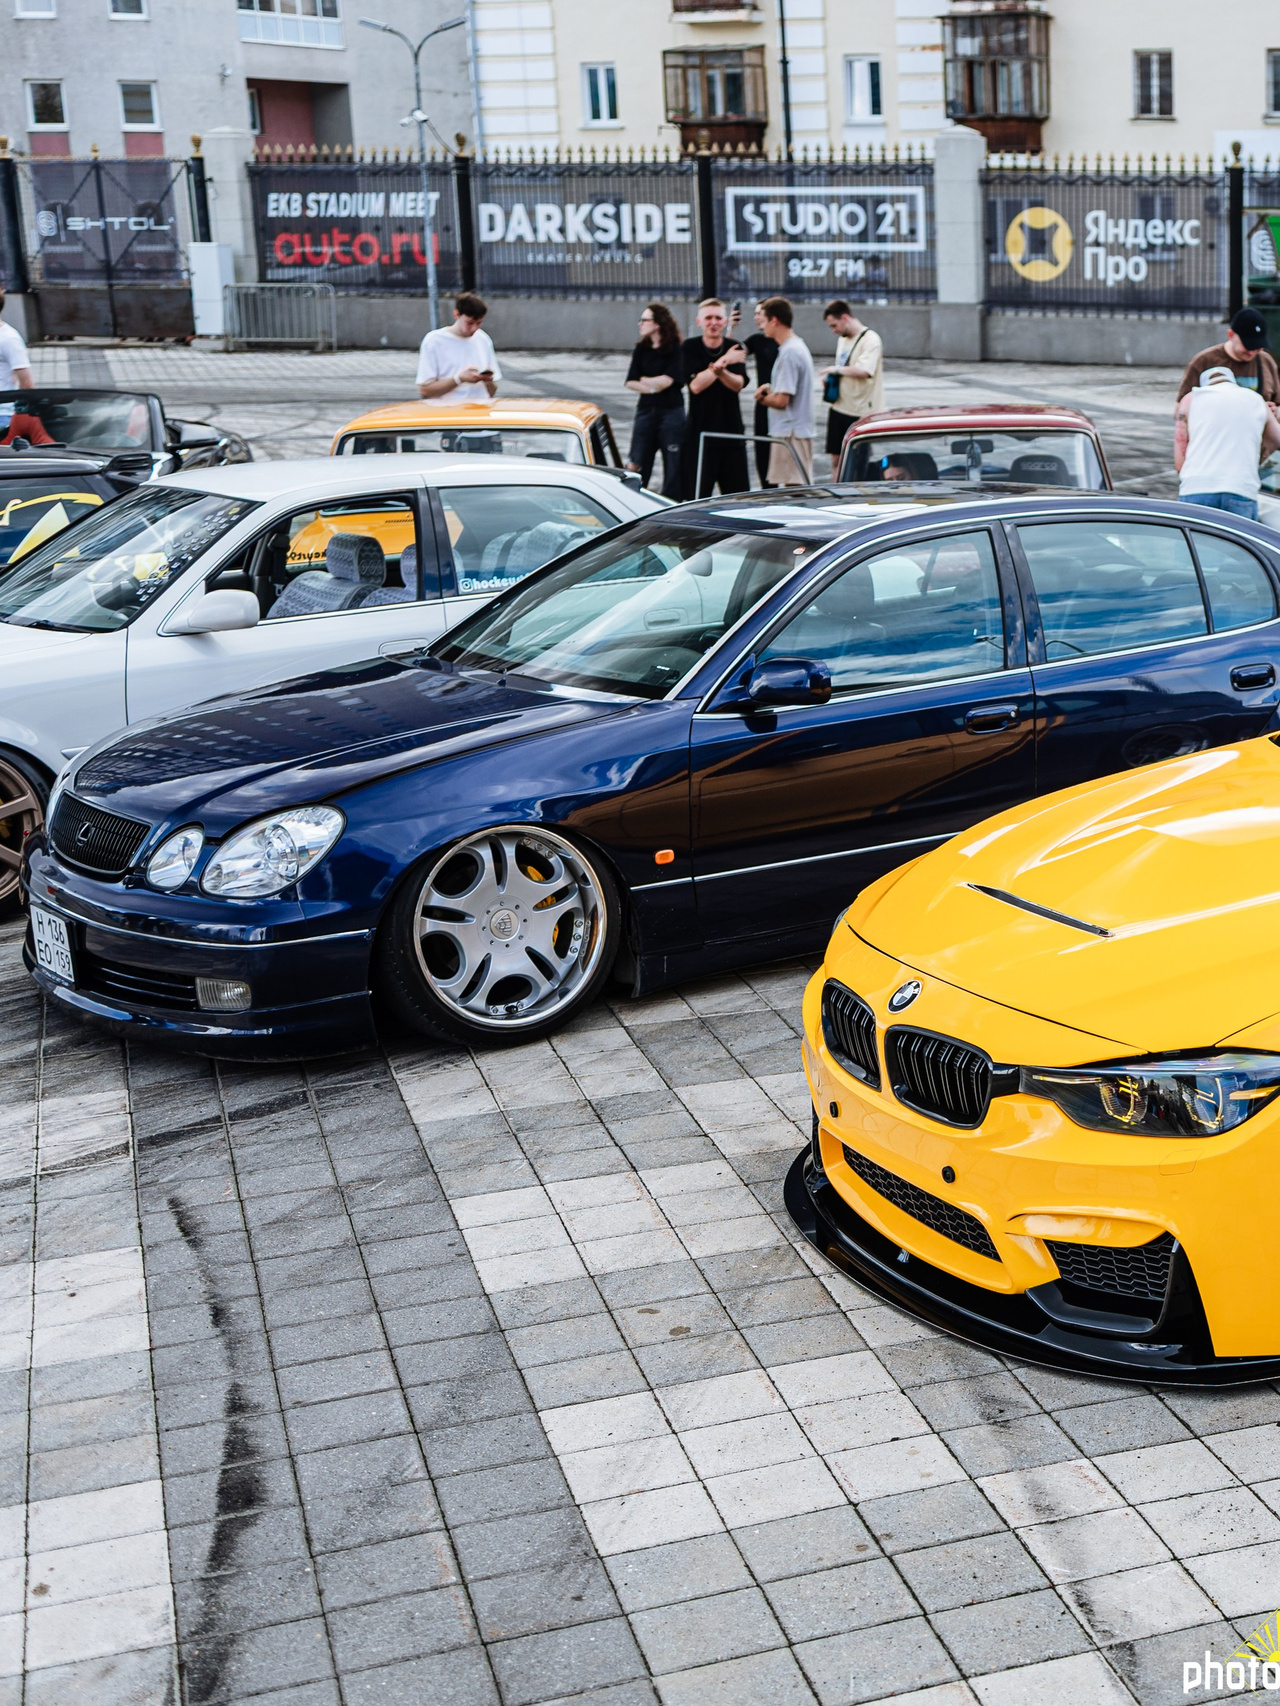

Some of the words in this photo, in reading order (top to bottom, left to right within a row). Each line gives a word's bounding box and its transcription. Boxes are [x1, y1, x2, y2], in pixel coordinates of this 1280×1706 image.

[267, 192, 302, 218] EKB
[306, 191, 385, 218] STADIUM
[389, 191, 440, 218] MEET
[742, 202, 868, 236] STUDIO
[875, 202, 908, 236] 21
[478, 202, 692, 244] DARKSIDE
[1084, 210, 1201, 249] Яндекс
[274, 227, 440, 265] auto.ru
[787, 257, 831, 279] 92.7
[835, 257, 865, 278] FM
[1084, 247, 1148, 287] Про
[48, 917, 65, 945] 136
[56, 950, 70, 972] 159
